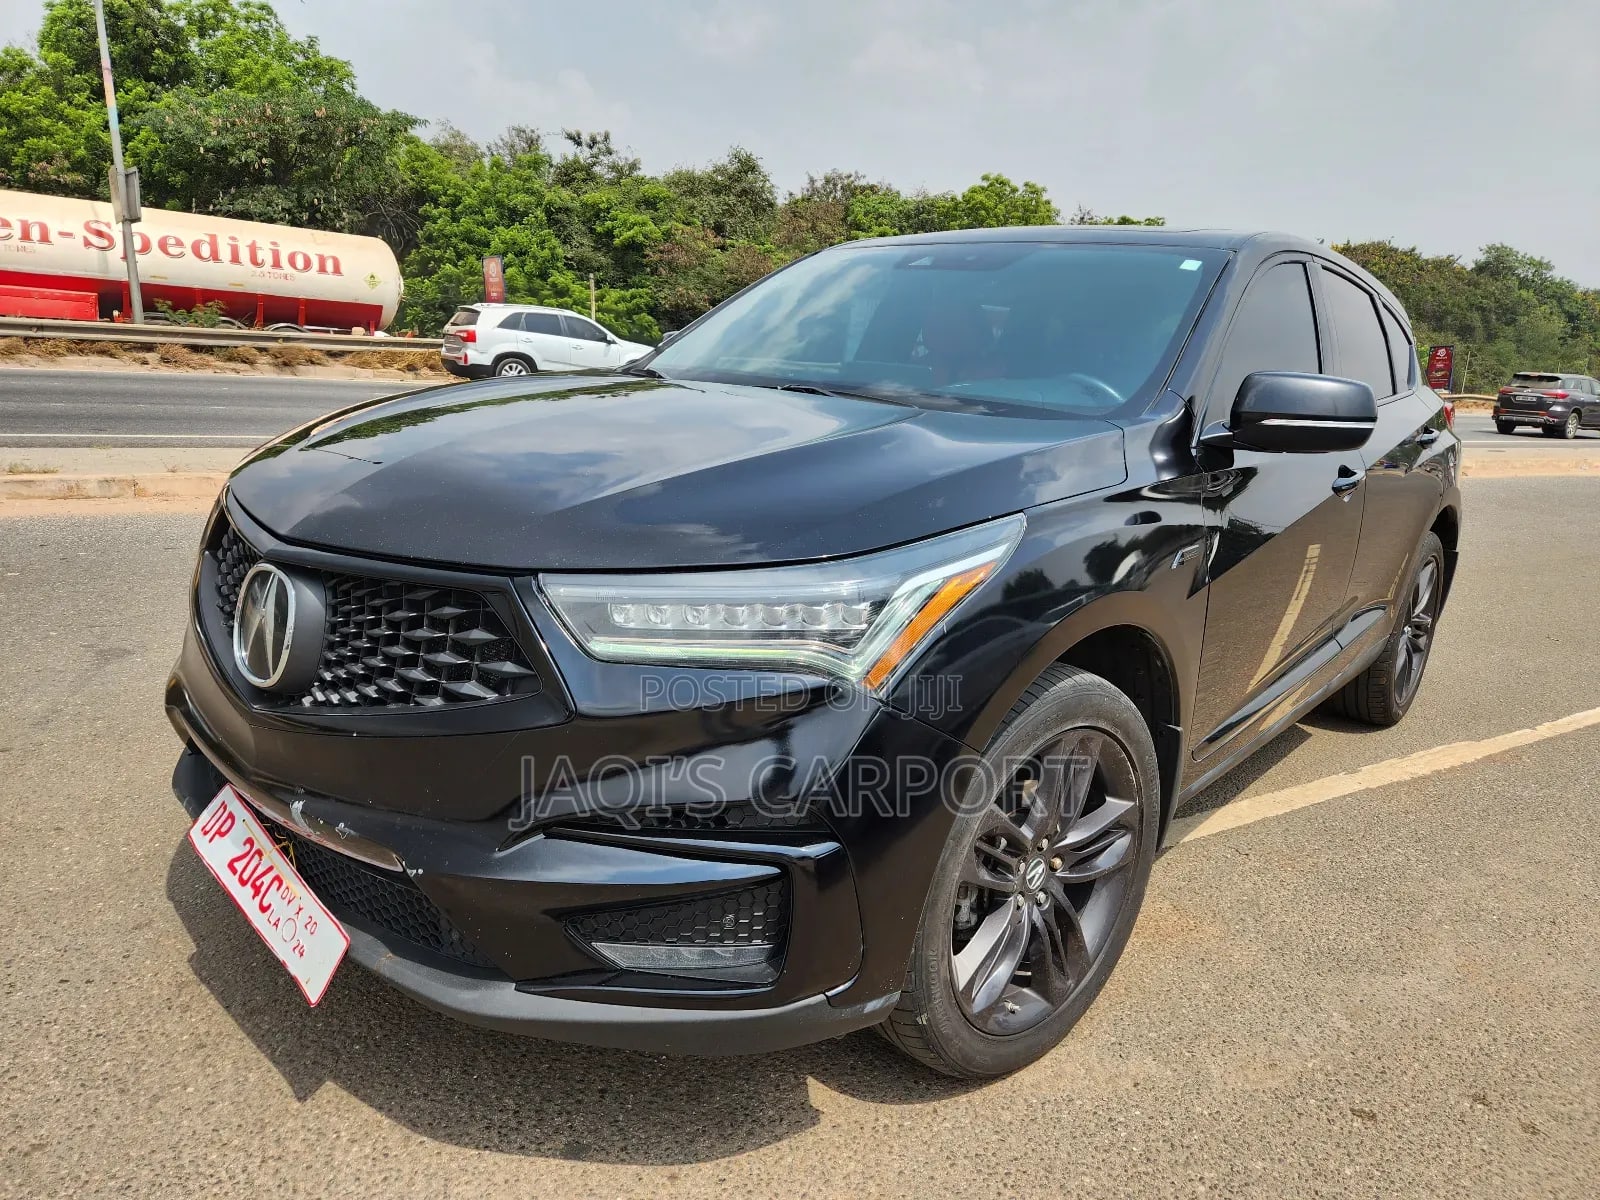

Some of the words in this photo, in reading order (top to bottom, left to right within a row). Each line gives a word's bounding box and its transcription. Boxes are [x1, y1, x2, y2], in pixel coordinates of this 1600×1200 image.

[201, 800, 236, 844] DP
[304, 914, 318, 935] 20
[292, 939, 305, 957] 24
